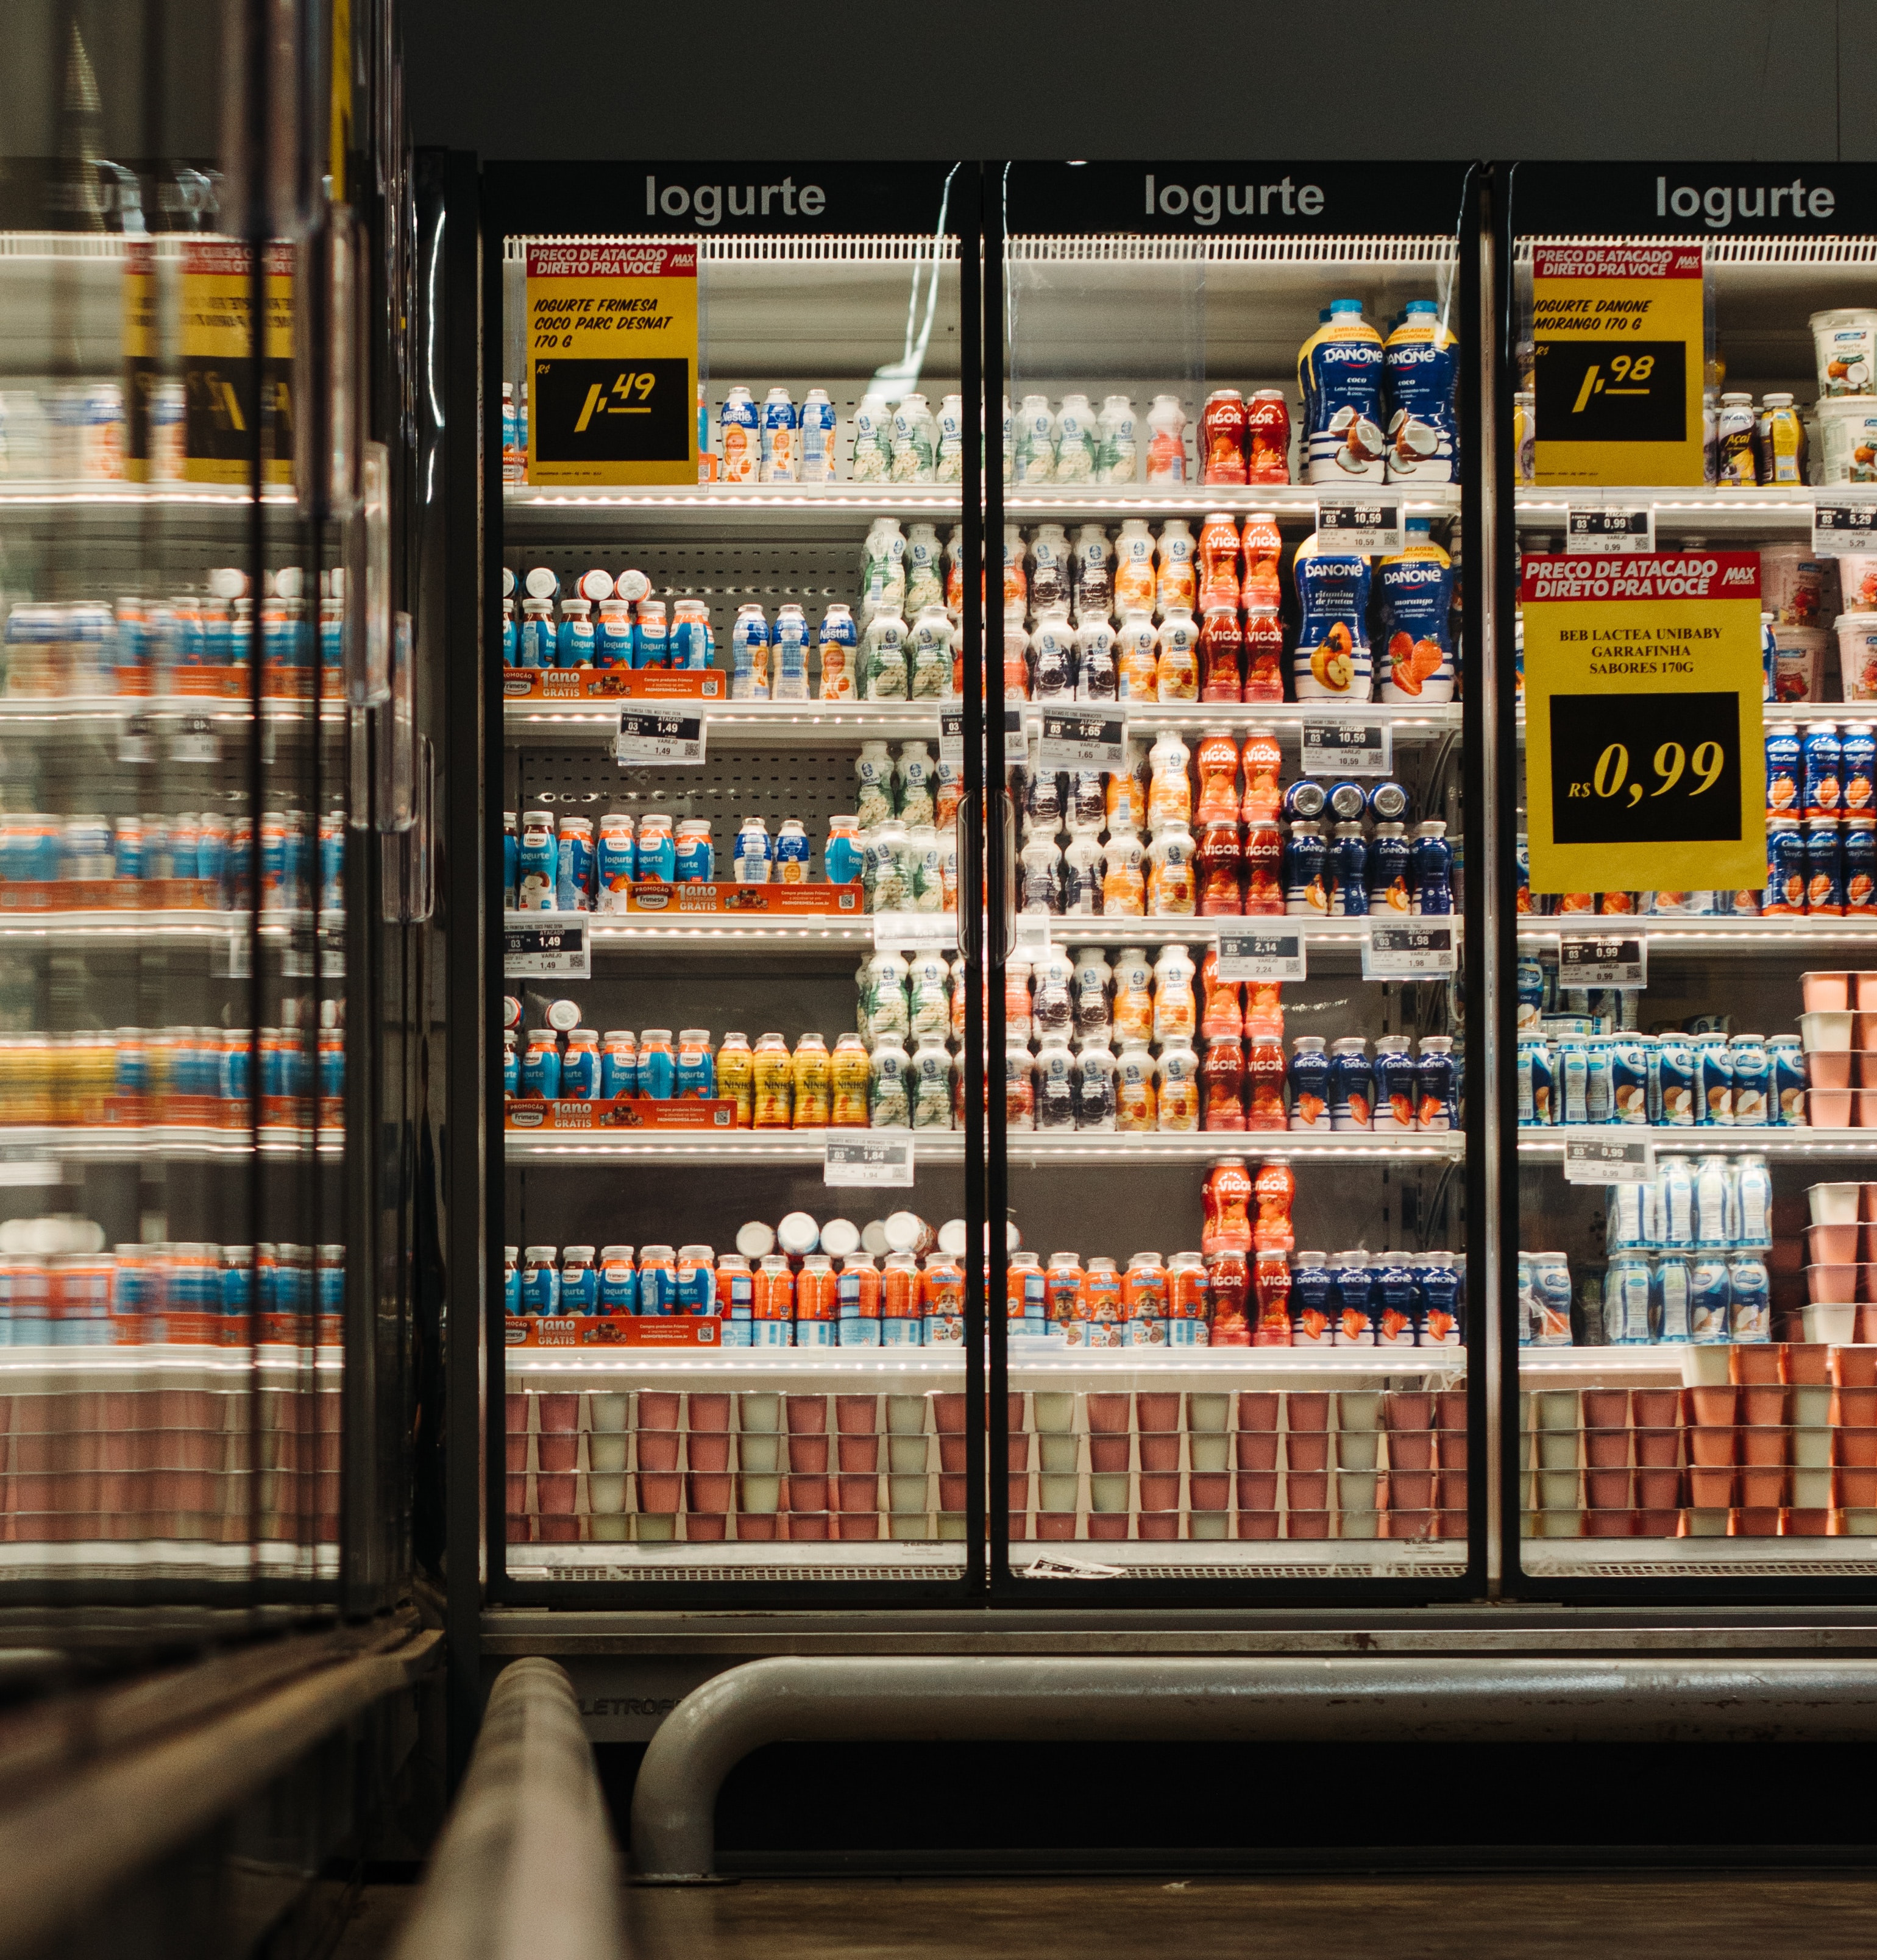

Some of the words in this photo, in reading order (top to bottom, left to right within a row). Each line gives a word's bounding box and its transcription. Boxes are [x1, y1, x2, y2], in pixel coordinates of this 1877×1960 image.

[647, 176, 826, 226] Iogurte
[1146, 174, 1325, 225] Iogurte
[1657, 176, 1836, 228] Iogurte
[530, 248, 577, 263] PREÇO
[580, 248, 599, 261] DE
[600, 248, 667, 261] ATACADO
[670, 254, 695, 267] MAX
[1536, 250, 1583, 265] PREÇO
[1586, 250, 1605, 262] DE
[1606, 250, 1673, 263] ATACADO
[537, 261, 589, 274] DIRETO
[592, 262, 620, 274] PRA
[623, 258, 662, 274] VOCÊ
[1543, 263, 1595, 275] DIRETO
[1597, 263, 1625, 275] PRA
[1629, 260, 1667, 275] VOCÊ
[1675, 256, 1700, 269] MAX
[534, 299, 594, 312] IOGURTE
[597, 299, 658, 311] FRIMESA
[1534, 300, 1593, 313] IOGURTE
[1595, 300, 1653, 313] DANONE
[534, 317, 571, 330] COCO
[575, 317, 613, 330] PARC
[616, 316, 673, 330] DESNAT
[1533, 318, 1601, 330] MORANGO
[1605, 318, 1628, 330] 170
[1632, 318, 1642, 330] G
[534, 335, 558, 347] 170
[562, 335, 572, 347] G
[1536, 346, 1549, 356] R$
[536, 364, 550, 374] R$
[1572, 355, 1655, 413] 1,98
[574, 373, 656, 433] 1,49
[1207, 413, 1242, 425] VIGOR
[1325, 514, 1336, 524] 03
[1354, 513, 1382, 524] 10,59
[1577, 519, 1587, 528] 03
[1603, 518, 1626, 529] 0,99
[1822, 514, 1833, 524] 03
[1850, 514, 1872, 525] 5,29
[1210, 536, 1240, 548] VIGO
[1525, 561, 1592, 583] PREÇO
[1595, 560, 1622, 578] DE
[1623, 559, 1718, 578] ATACADO
[1721, 567, 1756, 585] MAX
[1535, 580, 1609, 598] DIRETO
[1611, 578, 1653, 597] PRA
[1655, 573, 1710, 595] VOCÊ
[1325, 597, 1354, 606] frutas
[1394, 598, 1433, 607] morango
[1247, 631, 1282, 642] VIGOR
[1560, 630, 1588, 642] BEB
[1592, 629, 1651, 641] LACTEA
[1656, 628, 1723, 640] UNIBABY
[1592, 645, 1691, 658] GARRAFINHA
[1590, 662, 1657, 675] SABORES
[1662, 661, 1694, 673] 170G
[628, 722, 638, 731] 03
[657, 722, 678, 733] 1,49
[948, 722, 959, 731] 03
[1050, 725, 1061, 734] 03
[1079, 725, 1101, 737] 1,65
[1310, 734, 1321, 742] 03
[1339, 733, 1366, 744] 10,59
[1078, 750, 1093, 759] 1,65
[1201, 751, 1237, 762] VIGOR
[1246, 751, 1280, 762] VIGOR
[1339, 758, 1359, 766] 10,59
[1568, 782, 1591, 798] R$
[1594, 741, 1724, 808] 0,99
[1204, 844, 1240, 856] VIGOR
[1246, 845, 1280, 856] VIGOR
[605, 855, 633, 864] Iogurte
[679, 900, 717, 911] GRÁTIS
[539, 937, 561, 948] 1,49
[1407, 936, 1429, 946] 1,98
[1227, 944, 1238, 953] 03
[1255, 942, 1277, 953] 2,14
[1569, 950, 1579, 959] 03
[1596, 947, 1618, 959] 0,99
[541, 962, 556, 970] 1,49
[1248, 1060, 1283, 1072] VIGOR
[555, 1118, 592, 1127] GRÁTIS
[863, 1151, 884, 1161] 1,84
[1601, 1147, 1623, 1158] 0,99
[603, 1288, 632, 1297] Iogurte
